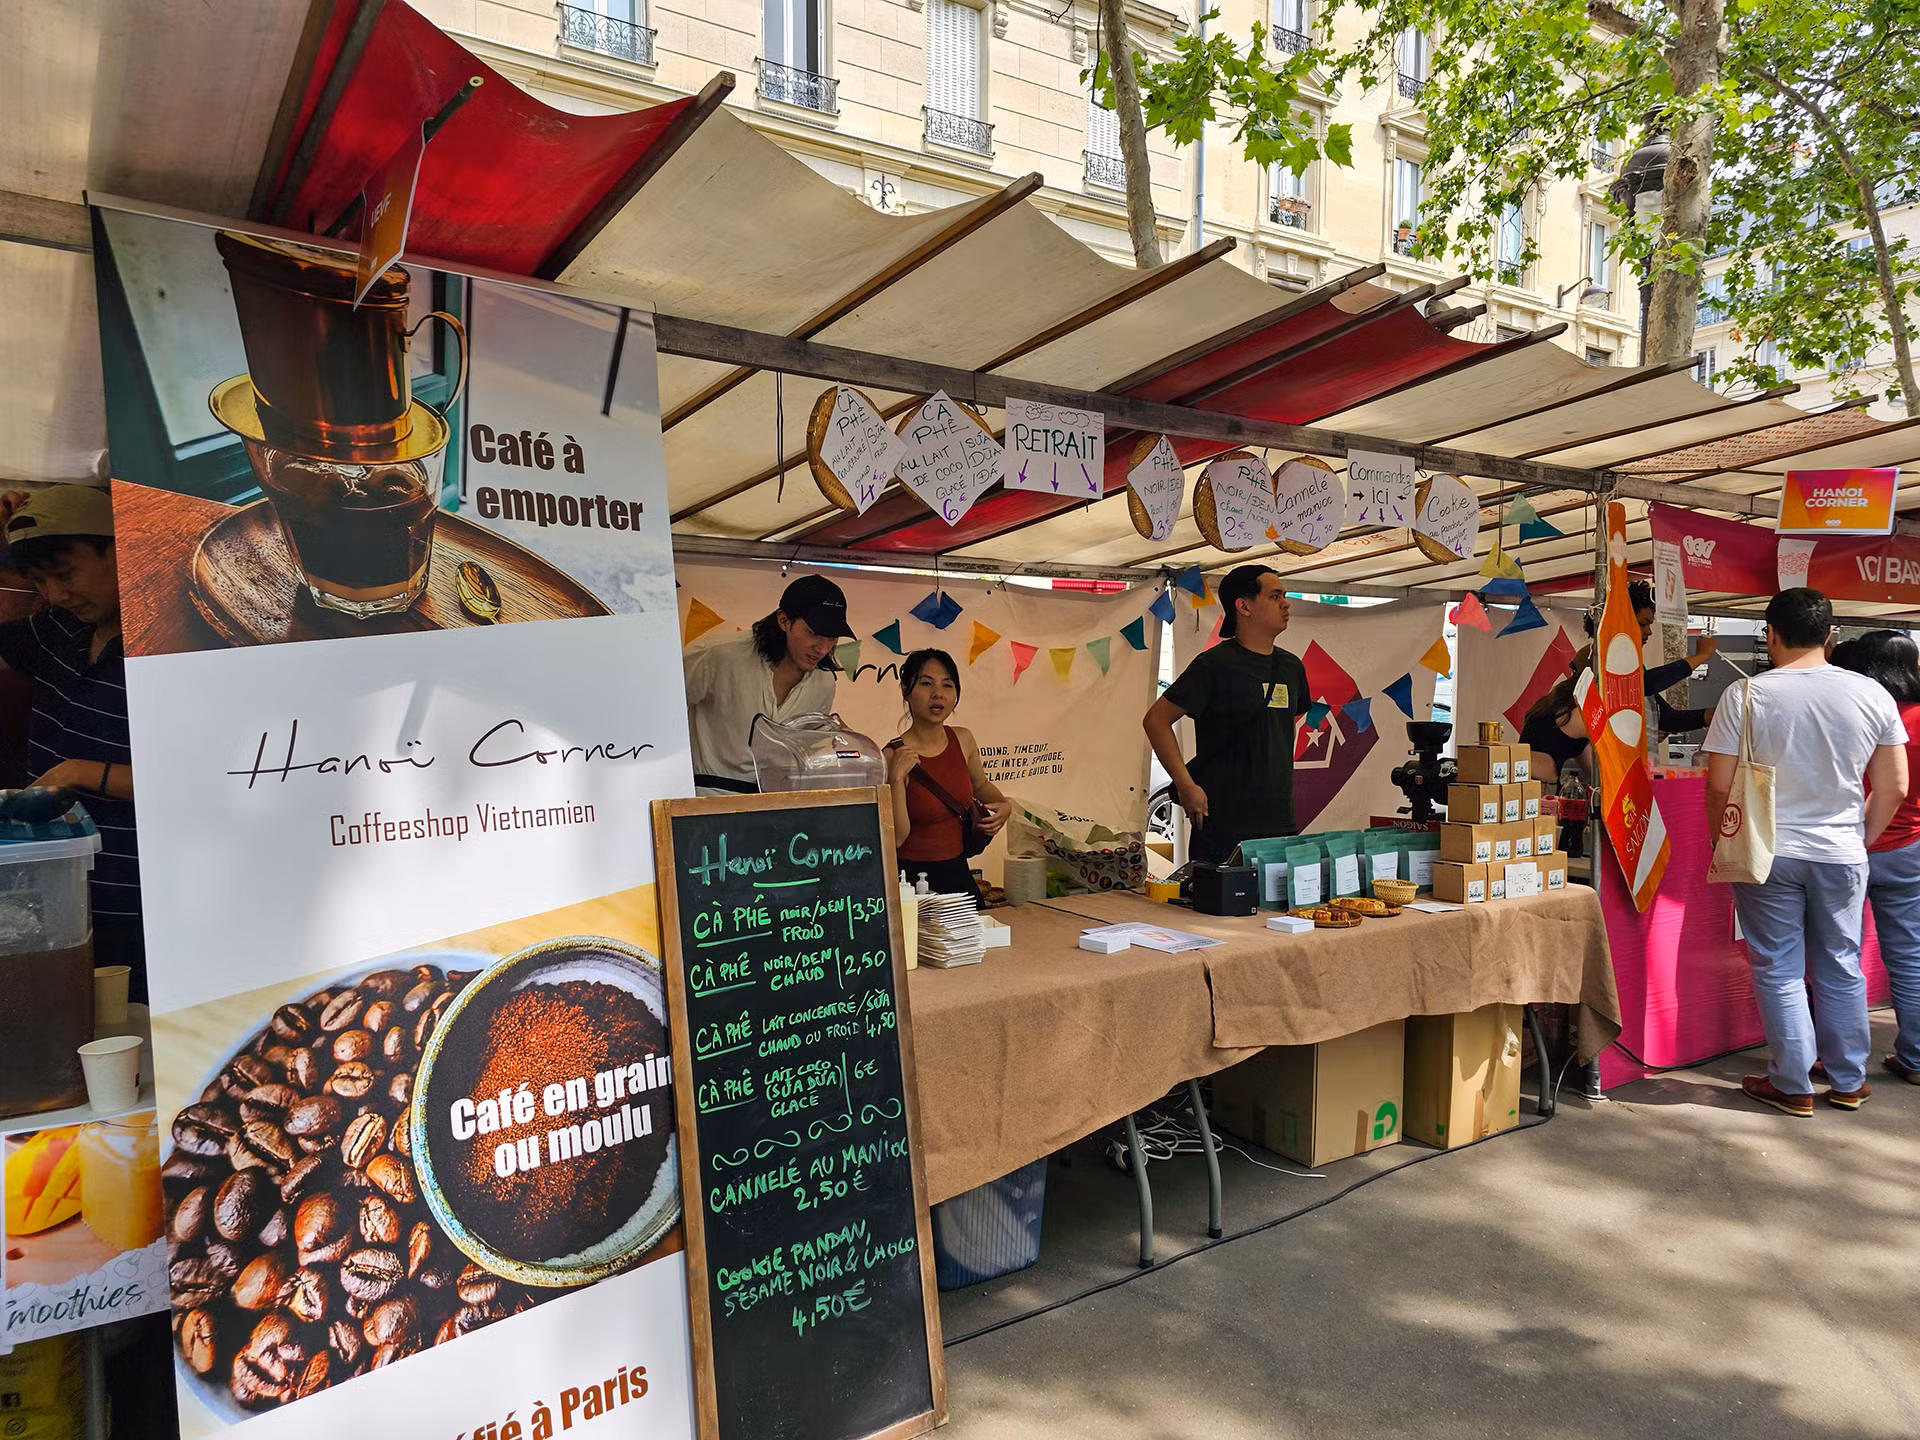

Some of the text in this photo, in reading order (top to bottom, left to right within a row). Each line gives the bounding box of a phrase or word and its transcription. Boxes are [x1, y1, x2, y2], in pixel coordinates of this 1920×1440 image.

[470, 423, 585, 474] Café à
[900, 458, 920, 473] AU
[922, 445, 949, 467] LAIT
[912, 472, 930, 488] DE
[935, 461, 964, 481] COCO
[935, 474, 968, 500] GLACÉ
[1275, 470, 1329, 515] Cannelé
[1349, 461, 1413, 496] Commandez
[1813, 488, 1863, 498] HANOI
[476, 486, 644, 531] emporter
[1280, 496, 1334, 531] au manioc
[1805, 498, 1868, 508] CORNER
[1856, 555, 1882, 583] ICI
[227, 719, 654, 789] Hanoï Corner
[330, 800, 596, 847] Coffeeshop Vietnamien
[788, 832, 873, 868] Corner
[693, 901, 723, 940] CÀ
[853, 897, 885, 922] 3,50
[782, 921, 825, 943] FROID
[690, 958, 716, 990] CÀ
[719, 951, 752, 981] PHÊ
[844, 950, 887, 976] 2,50
[770, 966, 825, 991] CHAUD
[695, 1023, 723, 1054] CÀ
[724, 1010, 753, 1045] PHÊ
[758, 1034, 802, 1058] CHAUD
[805, 1028, 821, 1046] OU
[865, 1012, 896, 1038] 4,50
[697, 1058, 879, 1109] CÀ PHÊ LAIT COCO 6€
[770, 1090, 820, 1119] GLACÉ
[450, 1082, 536, 1141] Café
[543, 1075, 588, 1116] en
[494, 1103, 652, 1178] ou moulu
[709, 1130, 909, 1213] CANNELÉ AU MANIOC
[724, 1237, 916, 1318] SÉSAME NOIR & CHOCO
[531, 1399, 554, 1440] à
[560, 1366, 649, 1430] Paris
